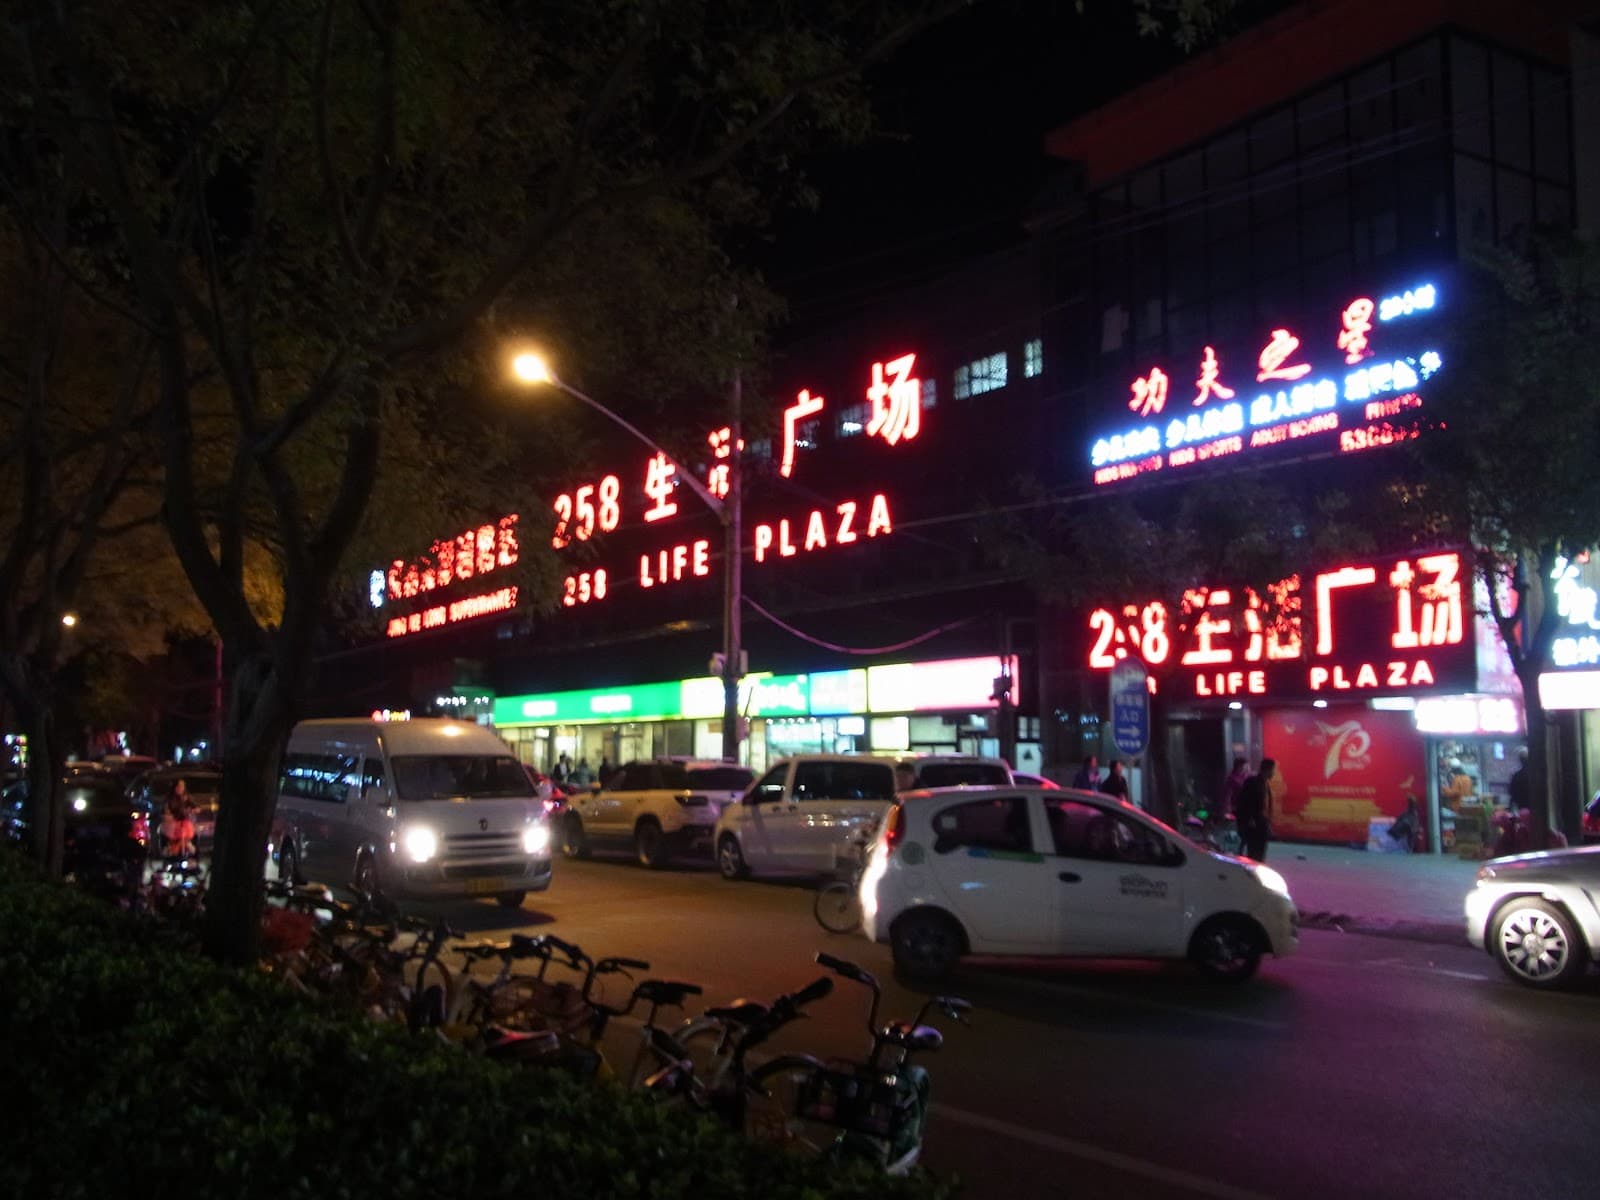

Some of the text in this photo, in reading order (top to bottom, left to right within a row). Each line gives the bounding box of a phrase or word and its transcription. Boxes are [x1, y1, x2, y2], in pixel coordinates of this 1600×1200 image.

[564, 494, 892, 606] 258 LIFE PLAZA
[1196, 659, 1434, 696] LIFE PLAZA
